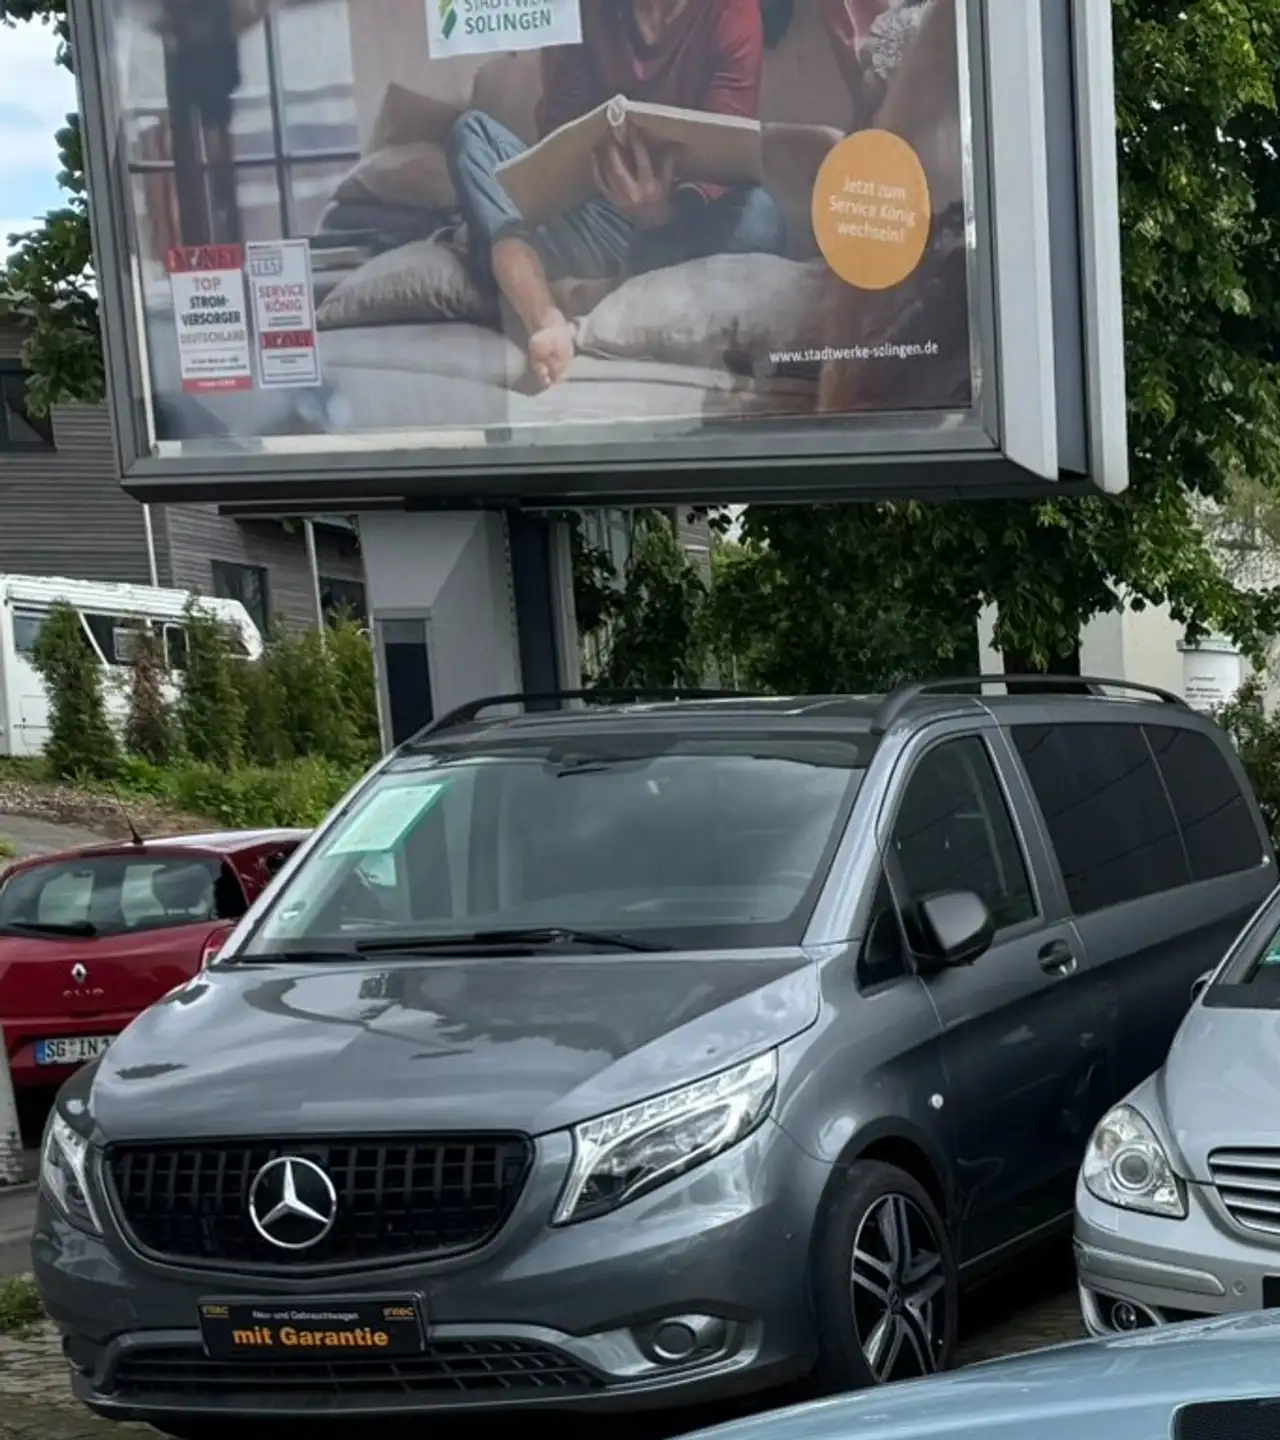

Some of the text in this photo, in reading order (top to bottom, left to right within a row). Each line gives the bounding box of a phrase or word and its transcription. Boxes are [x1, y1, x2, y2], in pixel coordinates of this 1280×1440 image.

[465, 10, 550, 34] SOLINGEN
[841, 176, 906, 200] Jetzt zum
[829, 194, 916, 229] Service König
[192, 276, 221, 292] TOP
[189, 294, 230, 309] STROM-
[181, 310, 241, 327] VERSORGER
[769, 339, 939, 363] www.stadtwerke-solingen.de
[46, 1040, 66, 1058] SG
[231, 1325, 390, 1347] mit Garantie
